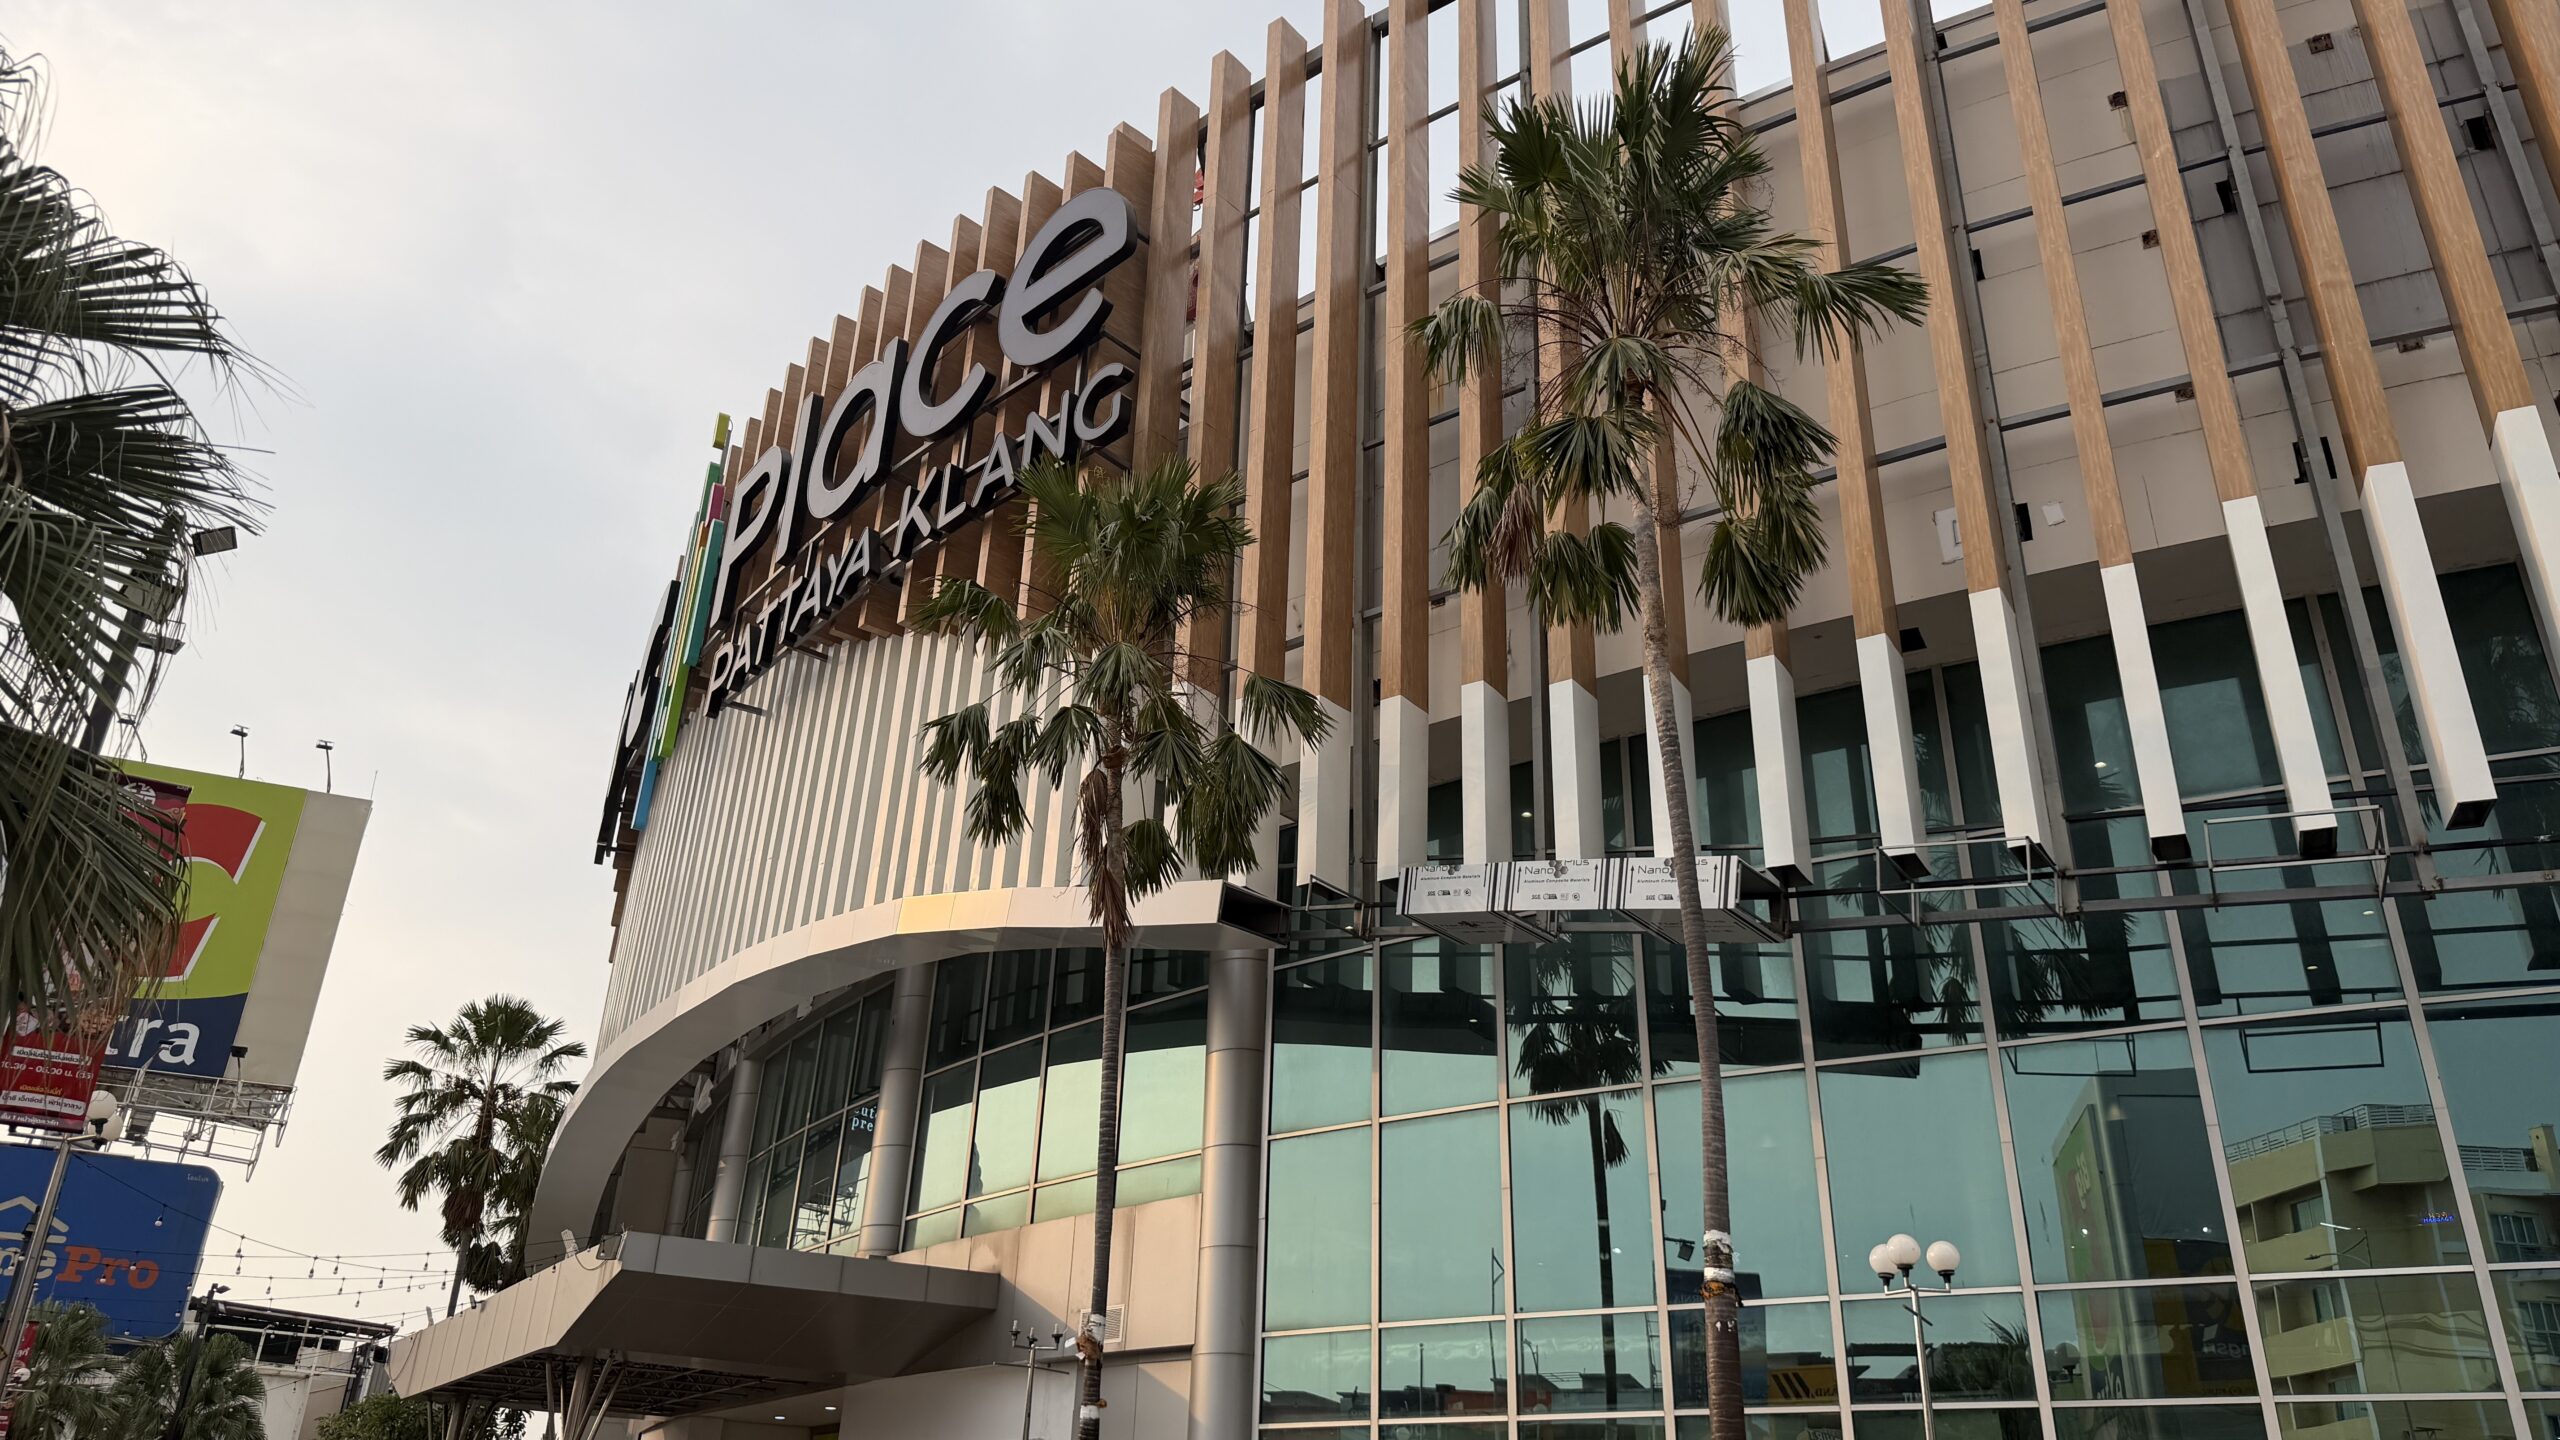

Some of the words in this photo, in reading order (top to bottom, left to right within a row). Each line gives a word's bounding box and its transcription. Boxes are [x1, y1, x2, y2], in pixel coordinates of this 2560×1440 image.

[705, 526, 881, 719] PATTAYA
[893, 363, 1133, 563] KLANG
[1524, 866, 1555, 875] Nano
[1637, 865, 1670, 875] Nano
